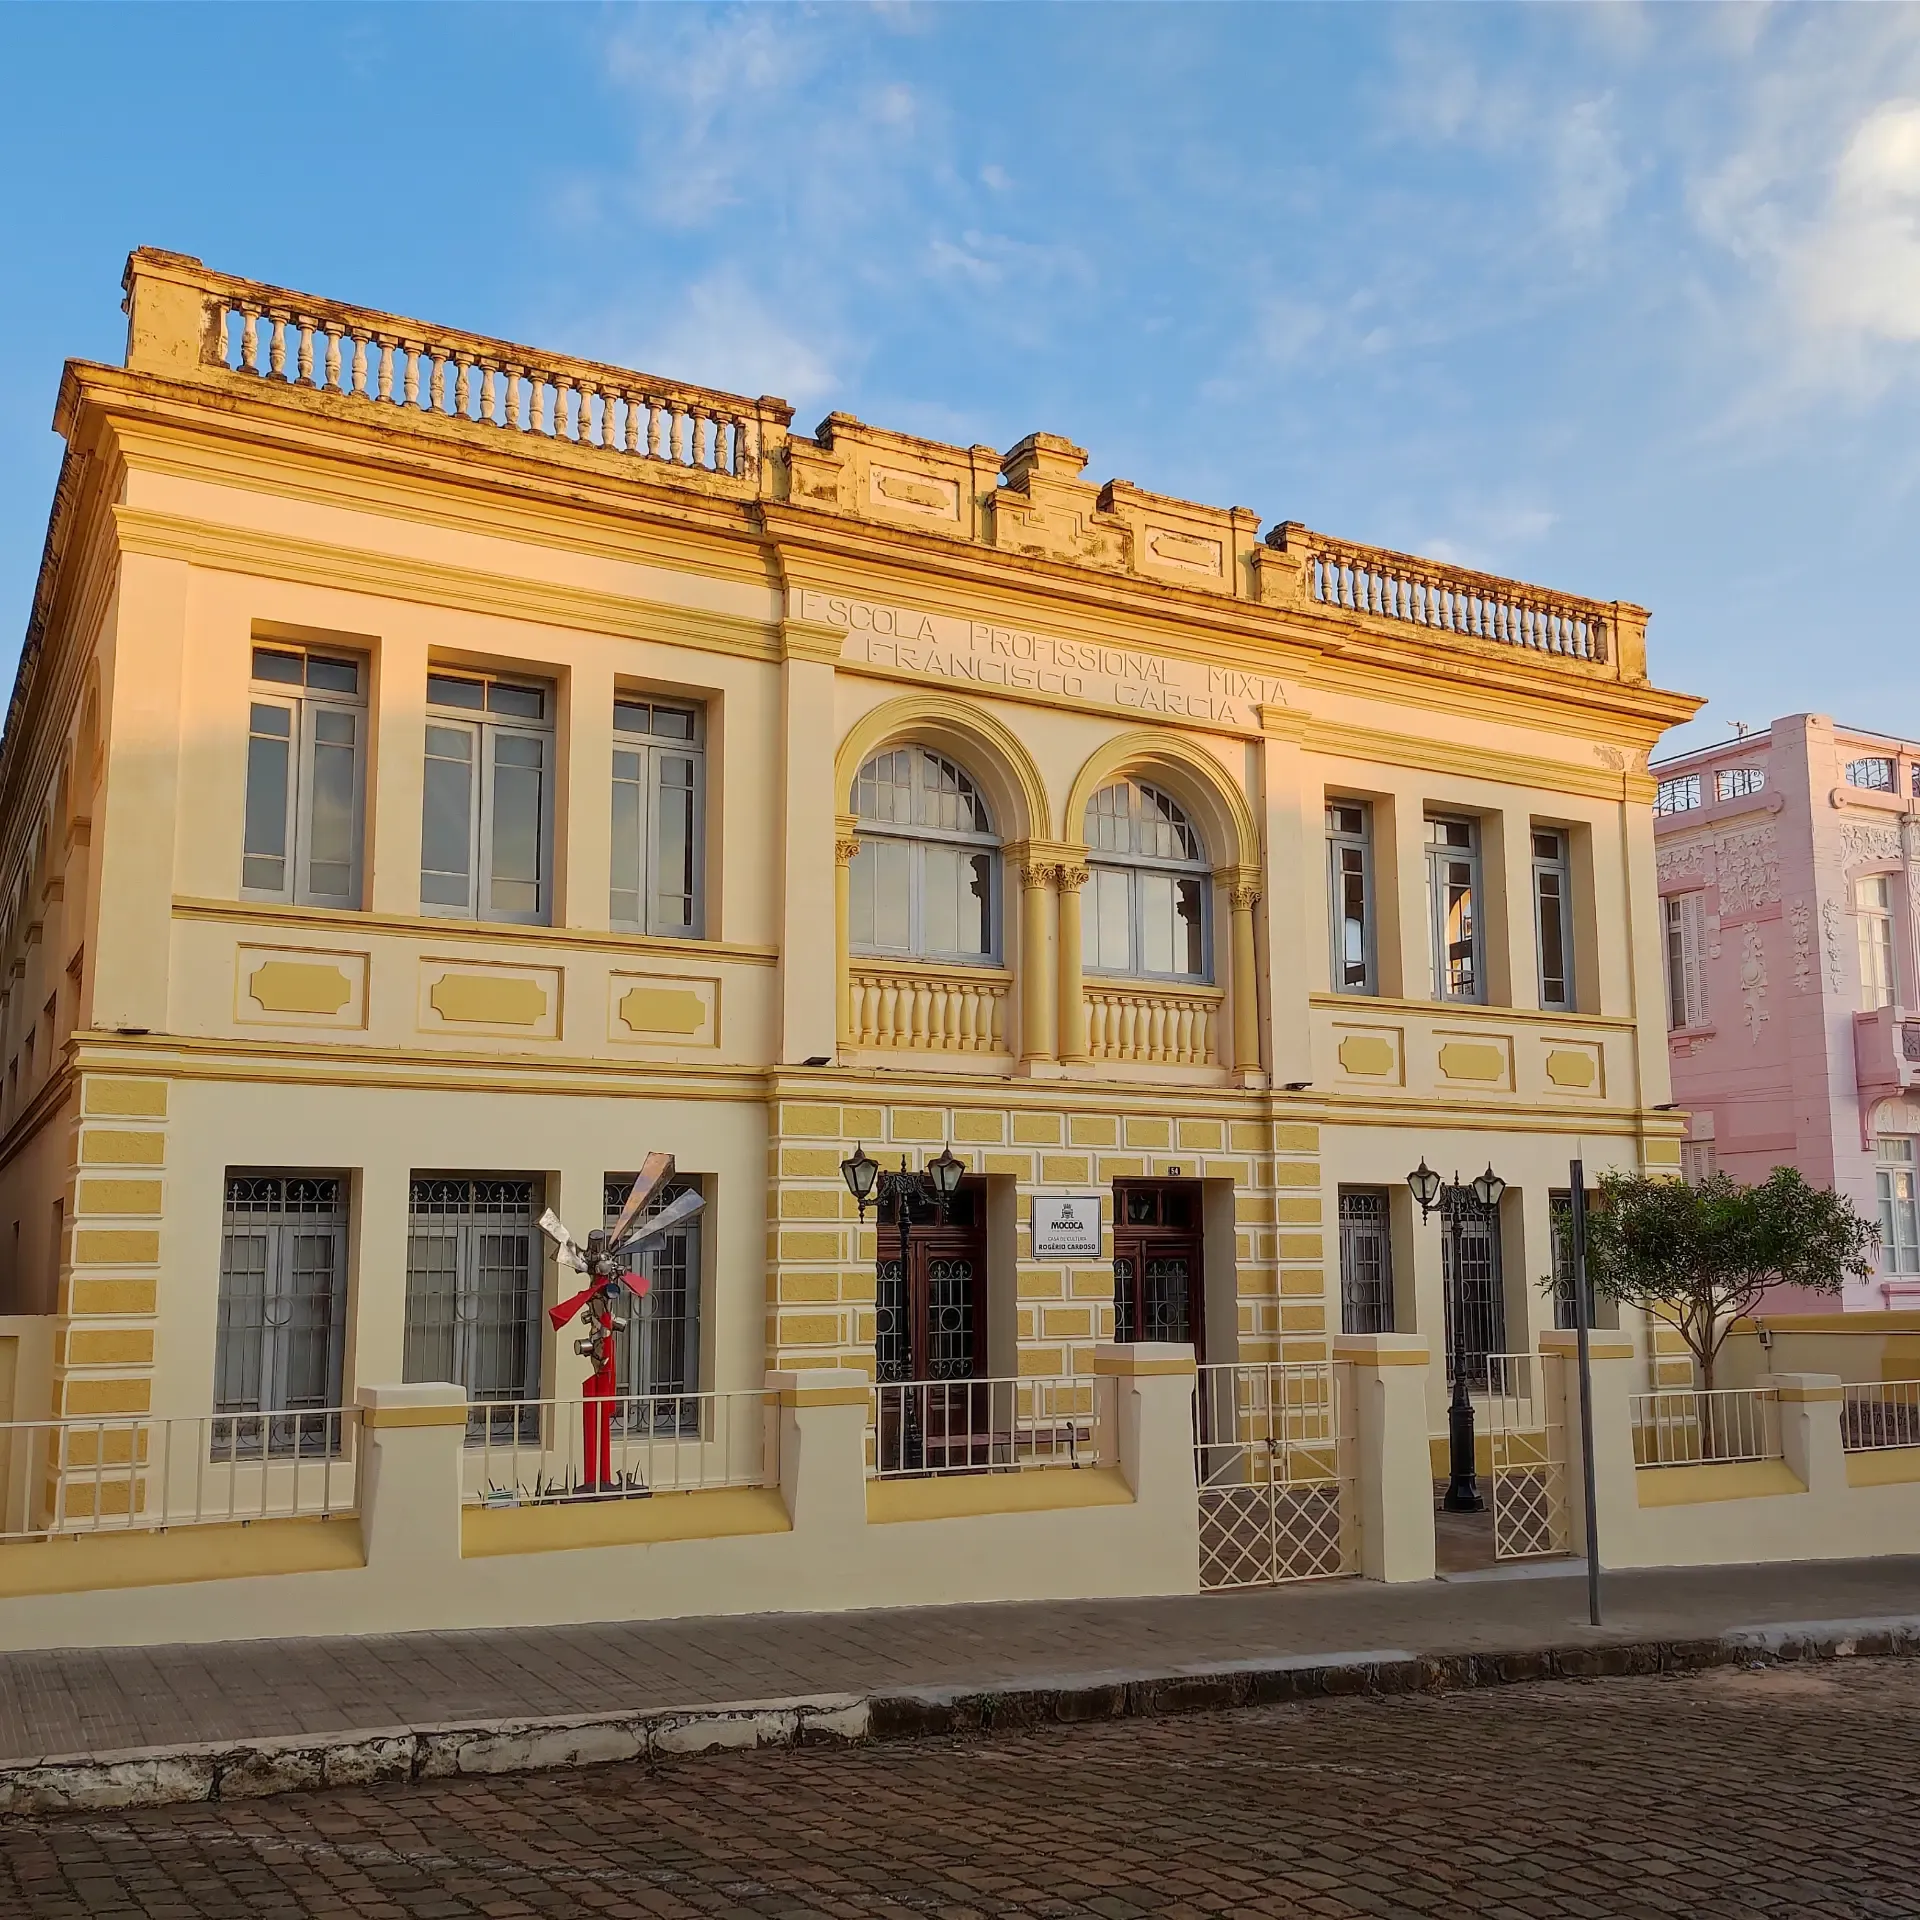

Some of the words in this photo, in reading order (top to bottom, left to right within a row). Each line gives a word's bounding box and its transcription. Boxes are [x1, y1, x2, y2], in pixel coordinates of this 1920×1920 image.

[801, 589, 938, 644] ESCOLA
[970, 621, 1181, 687] PROFISSIONAL
[1208, 665, 1288, 705] MIXTA
[867, 638, 1084, 698] FRANCISCO
[1115, 682, 1239, 724] GARCIA
[1051, 1221, 1084, 1230] MOCOCA
